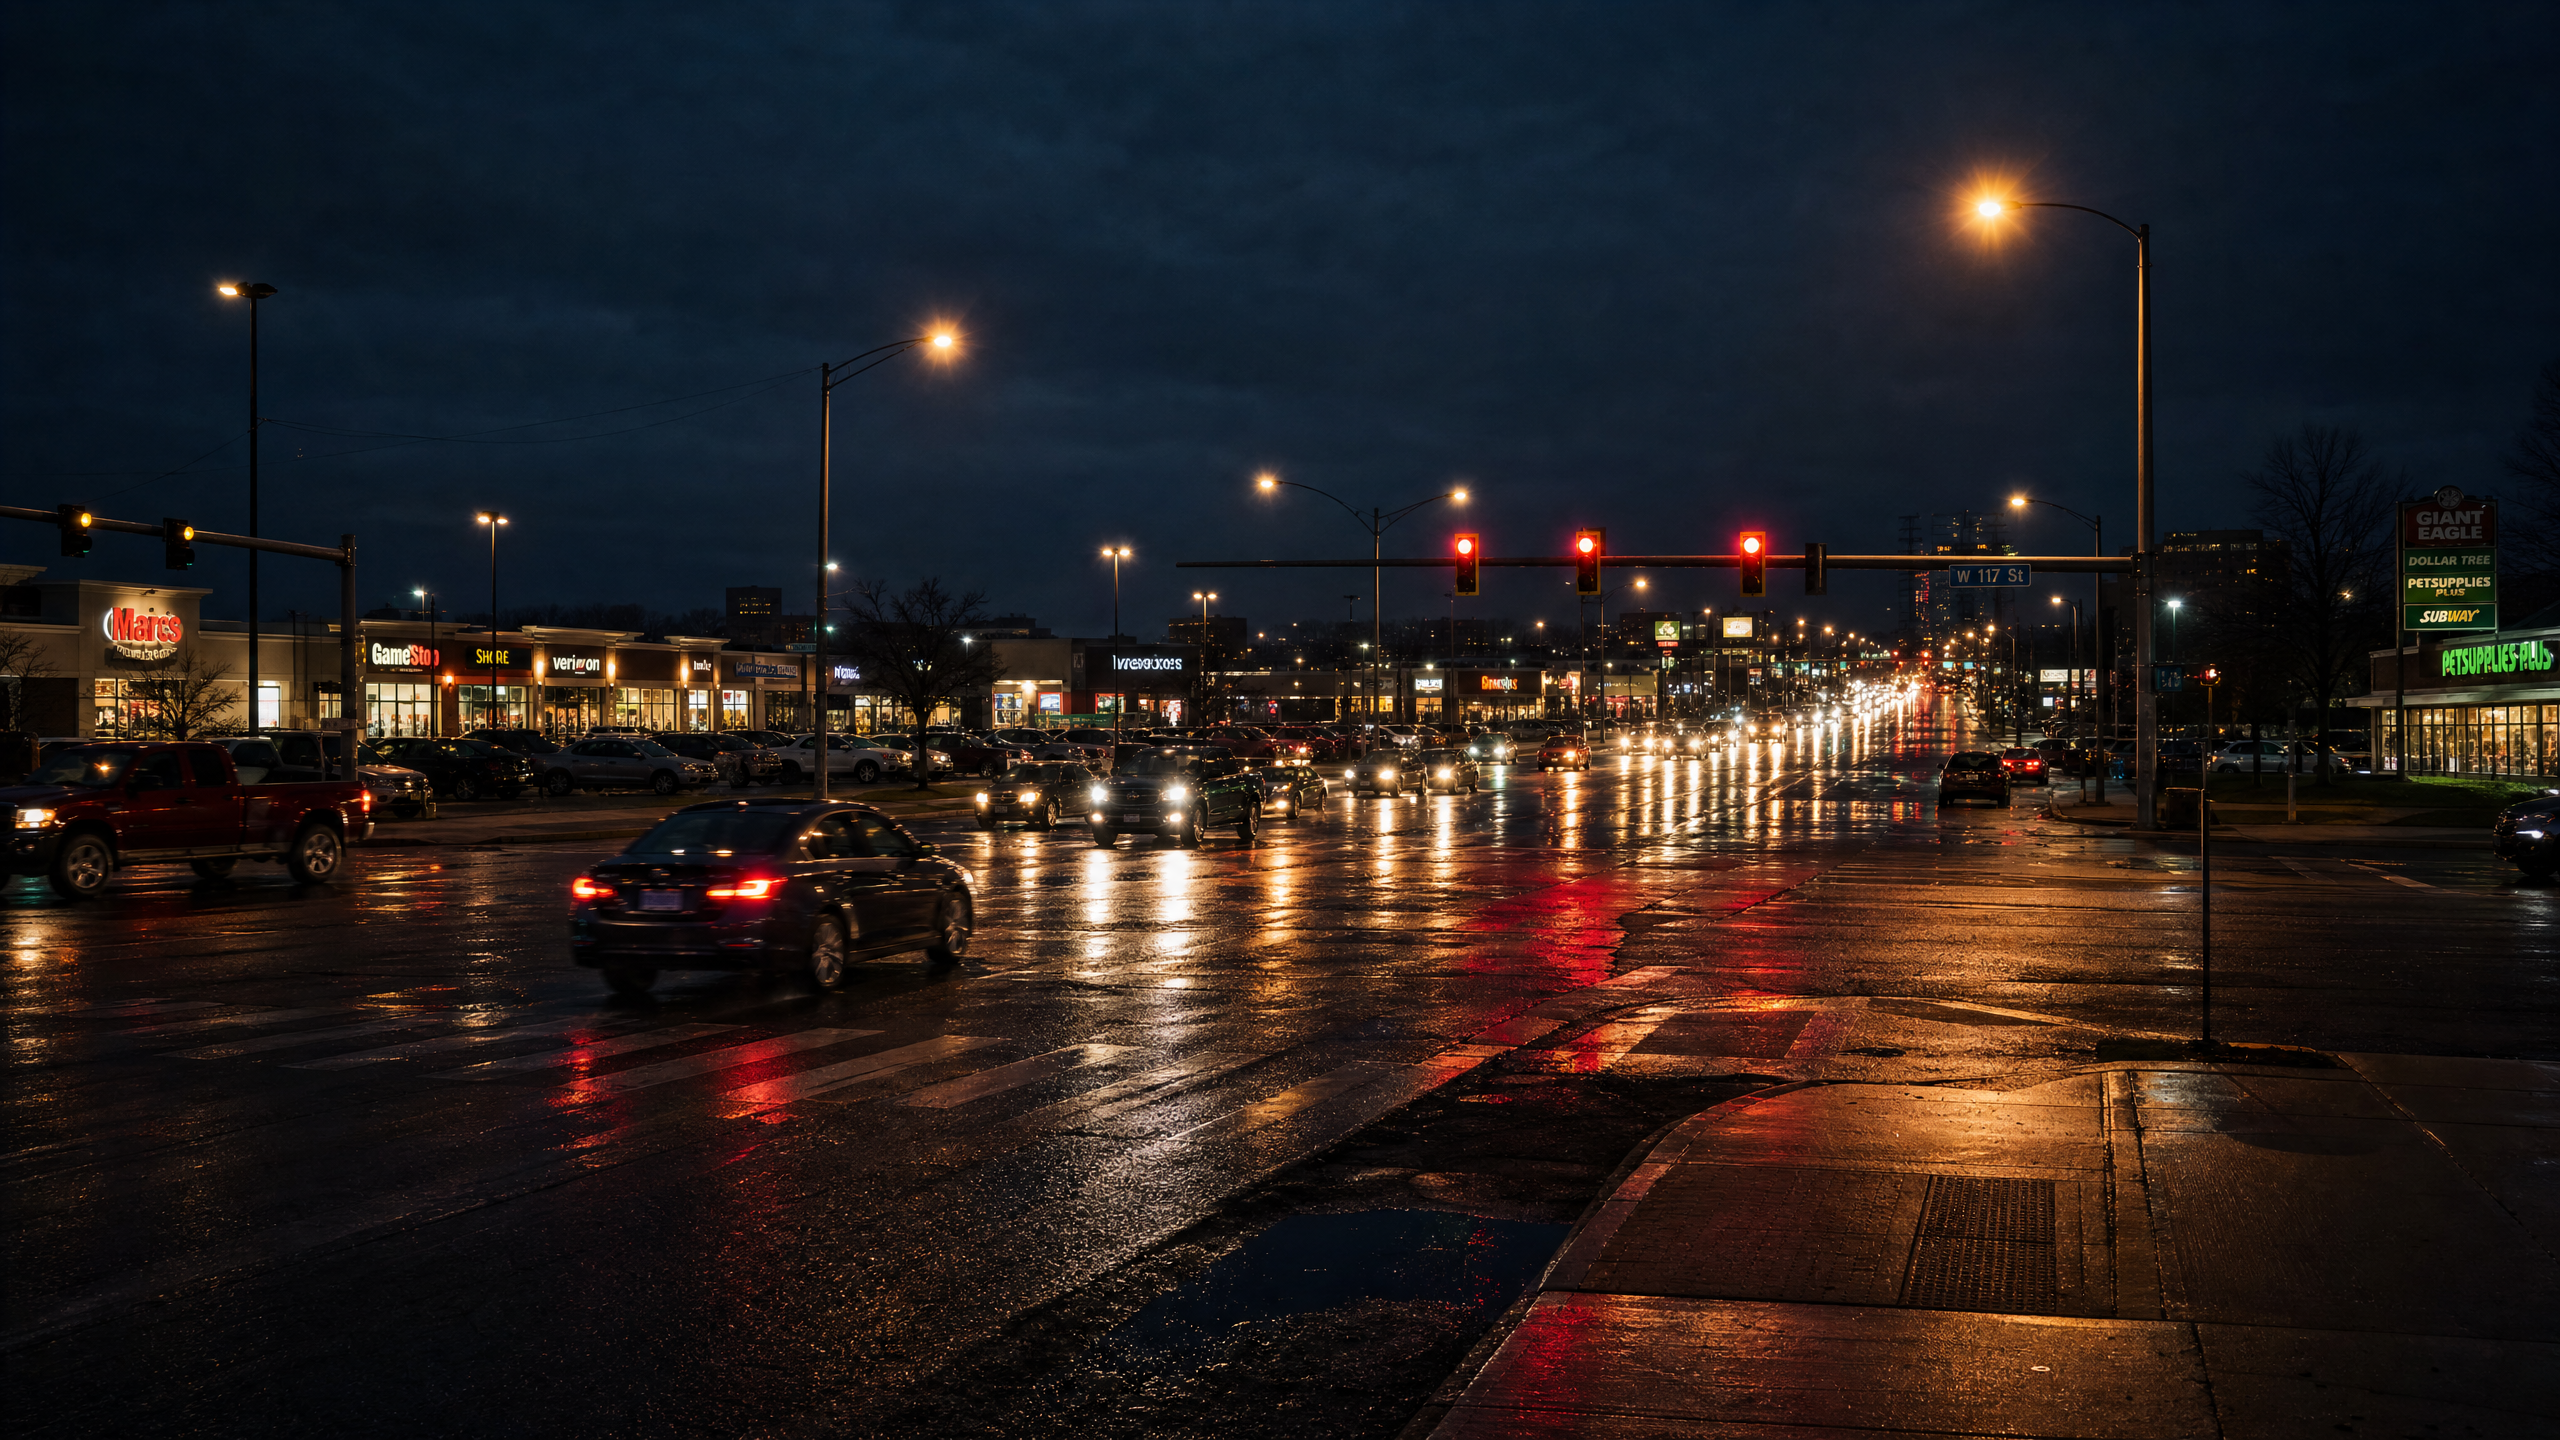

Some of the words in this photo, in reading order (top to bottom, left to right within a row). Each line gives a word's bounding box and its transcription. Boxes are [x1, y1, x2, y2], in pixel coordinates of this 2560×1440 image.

[2416, 510, 2484, 525] GIANT
[2418, 526, 2483, 540] EAGLE
[2408, 556, 2457, 566] DOLLAR
[2461, 555, 2491, 565] TREE
[1957, 569, 1970, 583] W
[1978, 568, 2000, 583] 117
[2008, 568, 2024, 583] St
[2408, 577, 2491, 589] PETSUPPLIES
[2435, 588, 2466, 597] PLUS
[2419, 609, 2479, 623] SUBWAY
[2442, 643, 2517, 676] PETSUPPLIES
[2519, 640, 2552, 671] PLUS
